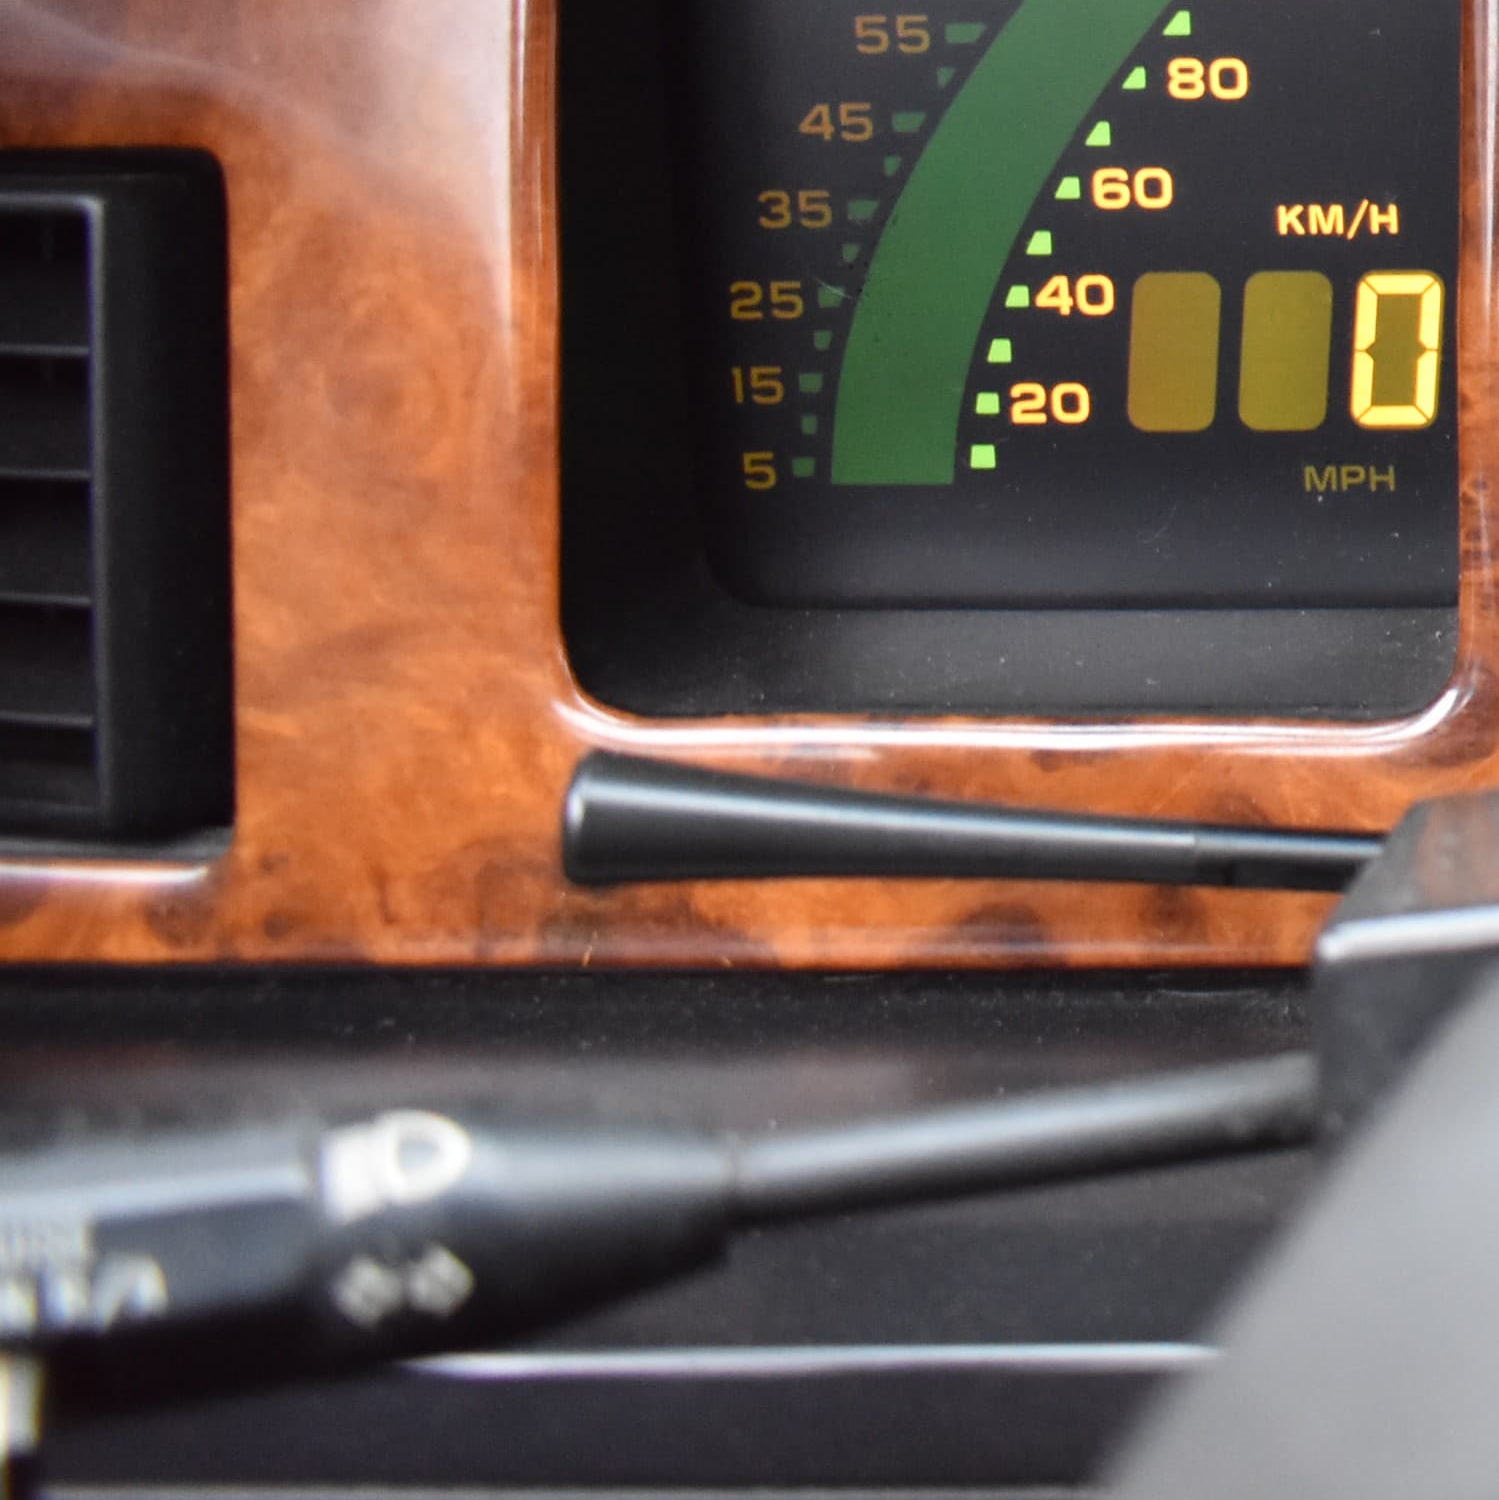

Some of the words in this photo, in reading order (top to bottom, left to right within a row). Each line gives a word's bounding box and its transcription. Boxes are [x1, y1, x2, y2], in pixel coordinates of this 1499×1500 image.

[854, 14, 931, 55] 55
[1166, 57, 1250, 100] 80
[799, 104, 875, 141] 45
[1091, 167, 1175, 210] 60
[758, 192, 834, 231] 35
[1276, 199, 1400, 241] KM/H
[729, 281, 804, 321] 25
[1034, 274, 1117, 315] 40
[732, 367, 785, 404] 15
[1009, 382, 1091, 424] 20
[743, 452, 777, 491] 5
[1303, 465, 1397, 493] MPH
